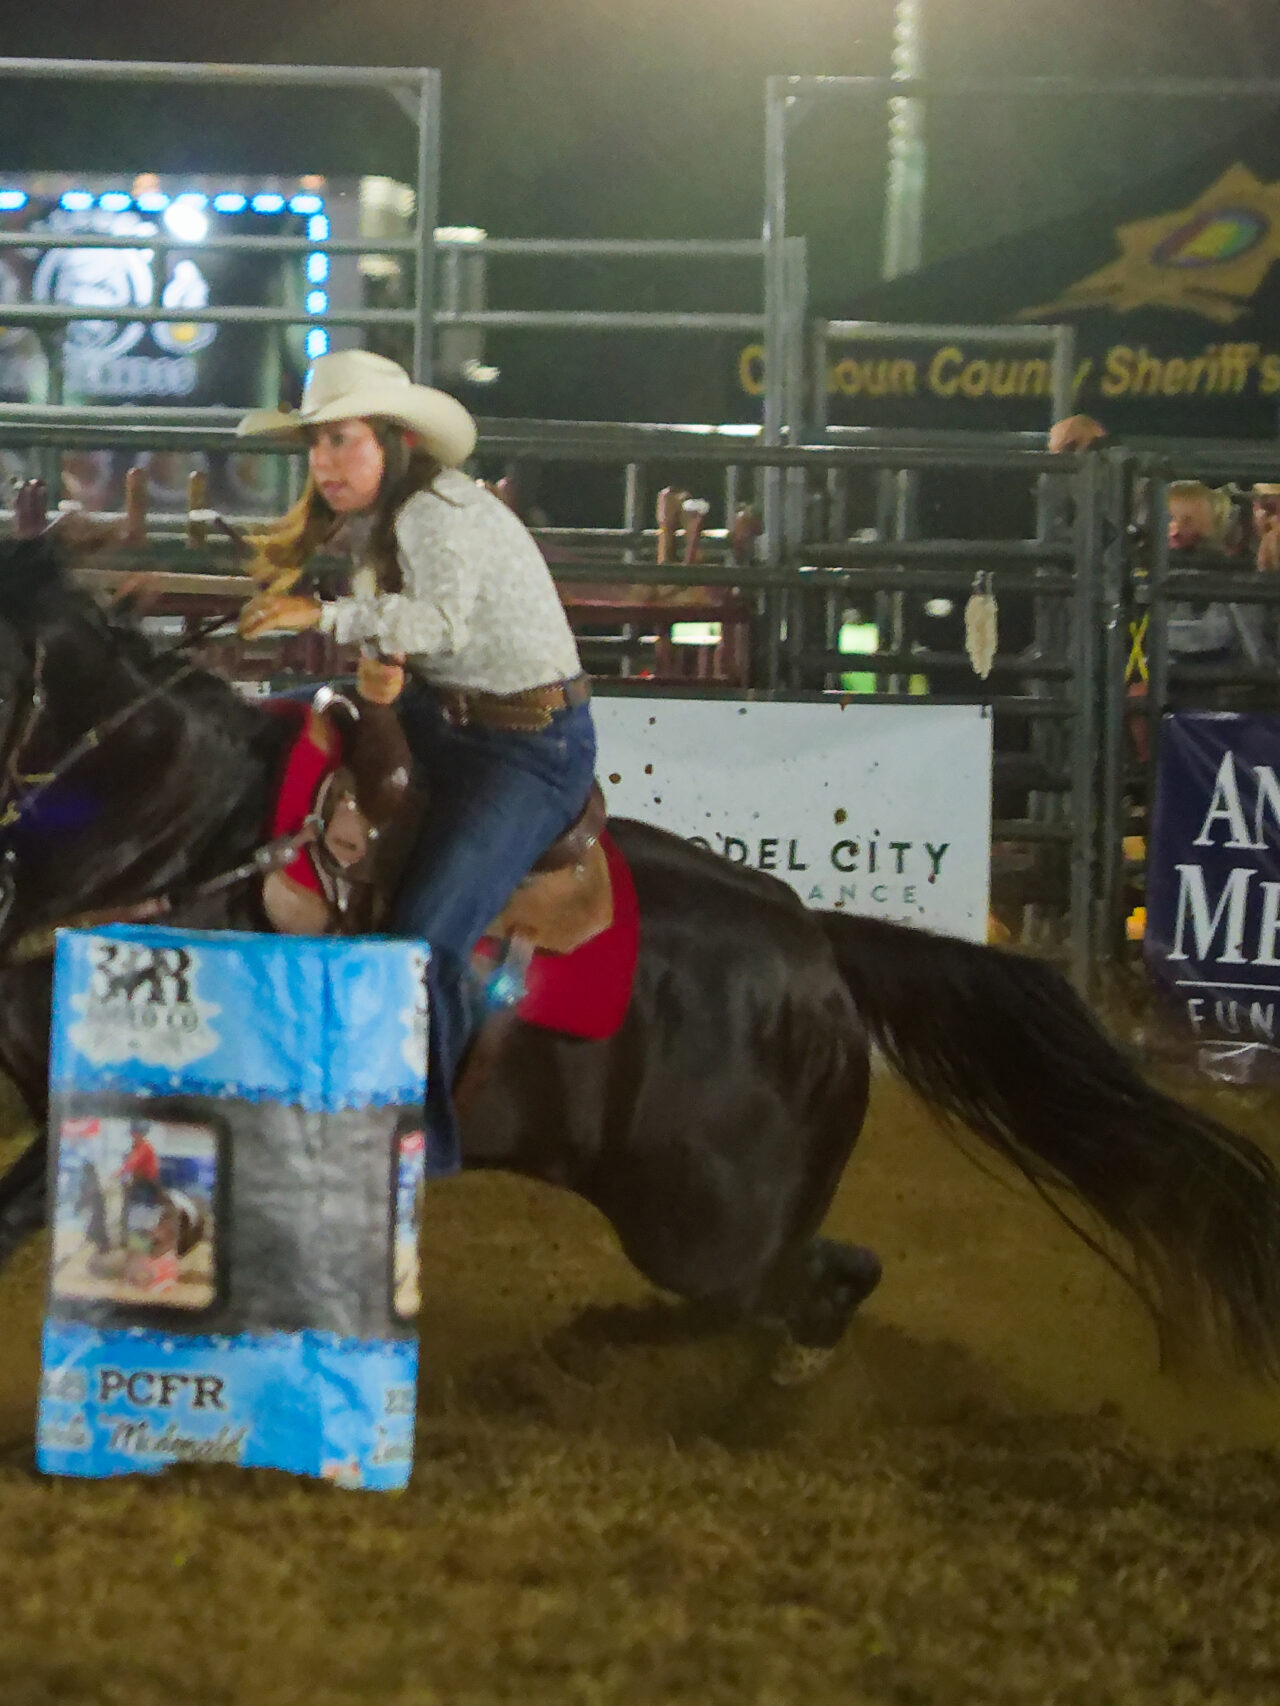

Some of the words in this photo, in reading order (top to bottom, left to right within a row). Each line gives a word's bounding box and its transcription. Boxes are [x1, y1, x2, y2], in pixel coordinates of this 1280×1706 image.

[739, 344, 916, 395] Coun
[930, 346, 1093, 396] Coun
[831, 838, 950, 875] CITY
[98, 1368, 227, 1409] PCFR
